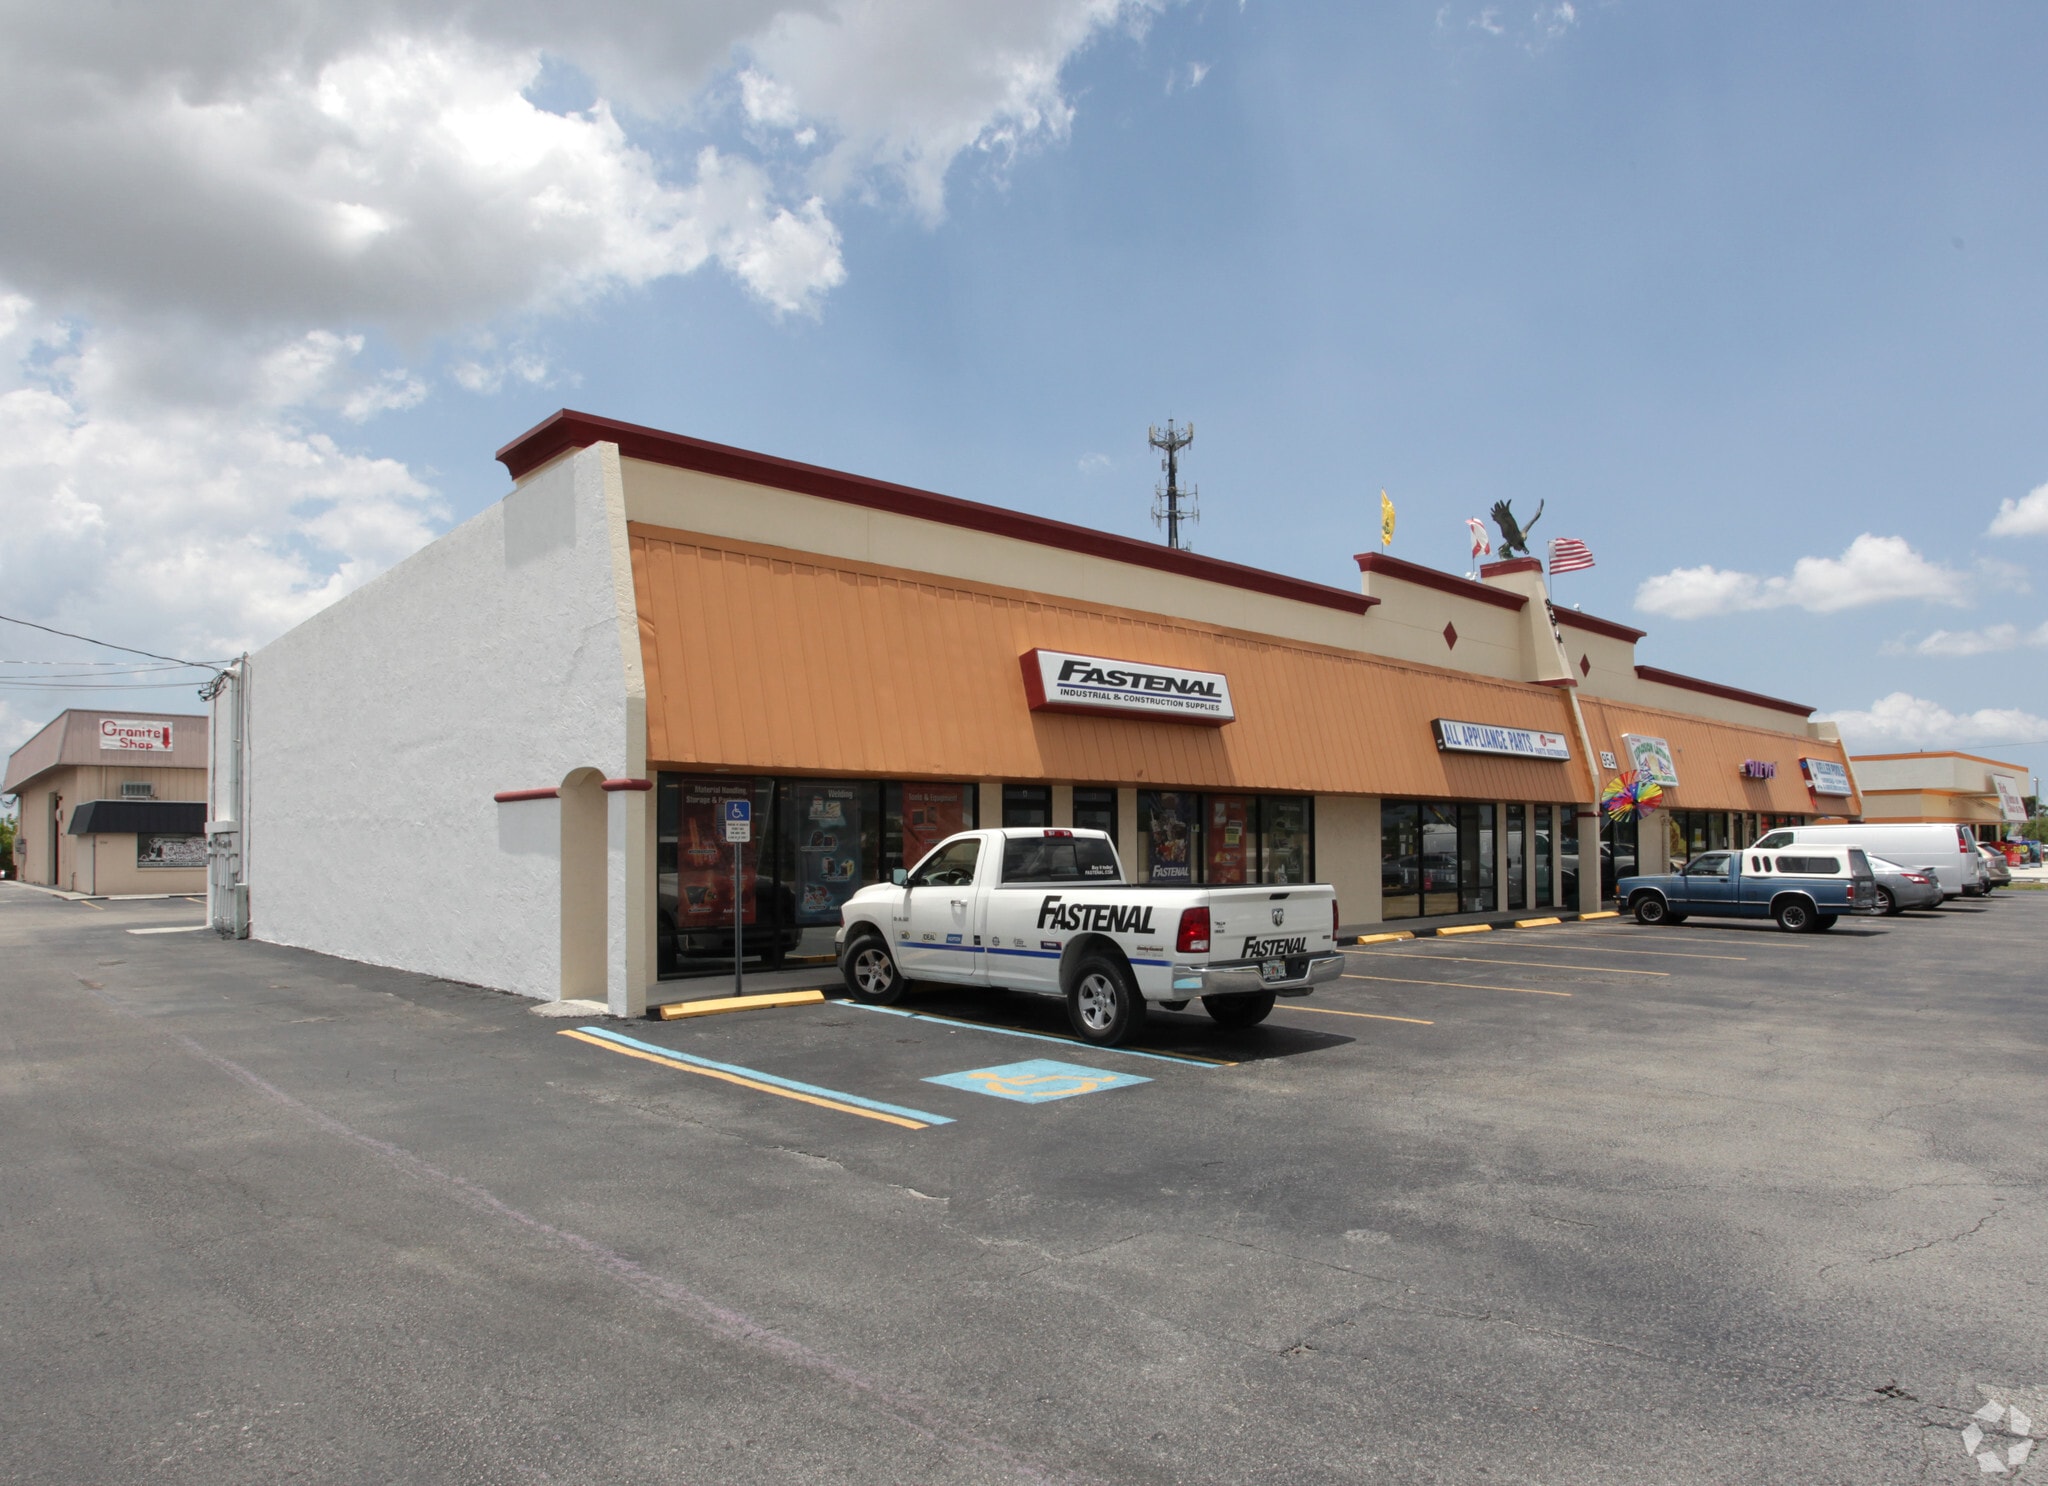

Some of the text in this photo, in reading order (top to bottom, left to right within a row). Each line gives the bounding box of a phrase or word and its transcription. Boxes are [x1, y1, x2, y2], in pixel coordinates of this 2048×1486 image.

[1057, 660, 1222, 698] FASTENAL
[1060, 688, 1220, 711] INDUSTRIAL & CONSTRUCTION SUPPLIES
[101, 720, 161, 739] Granite
[119, 737, 154, 751] Shop
[1444, 723, 1534, 753] ALL APPLIANCE PARTS
[1601, 753, 1616, 767] 954
[694, 785, 720, 794] Material
[828, 789, 853, 799] Welding
[686, 795, 710, 805] Storage
[1152, 865, 1190, 878] FASTENAL
[1037, 895, 1156, 935] FASTENAL
[1241, 936, 1307, 959] FASTENAL
